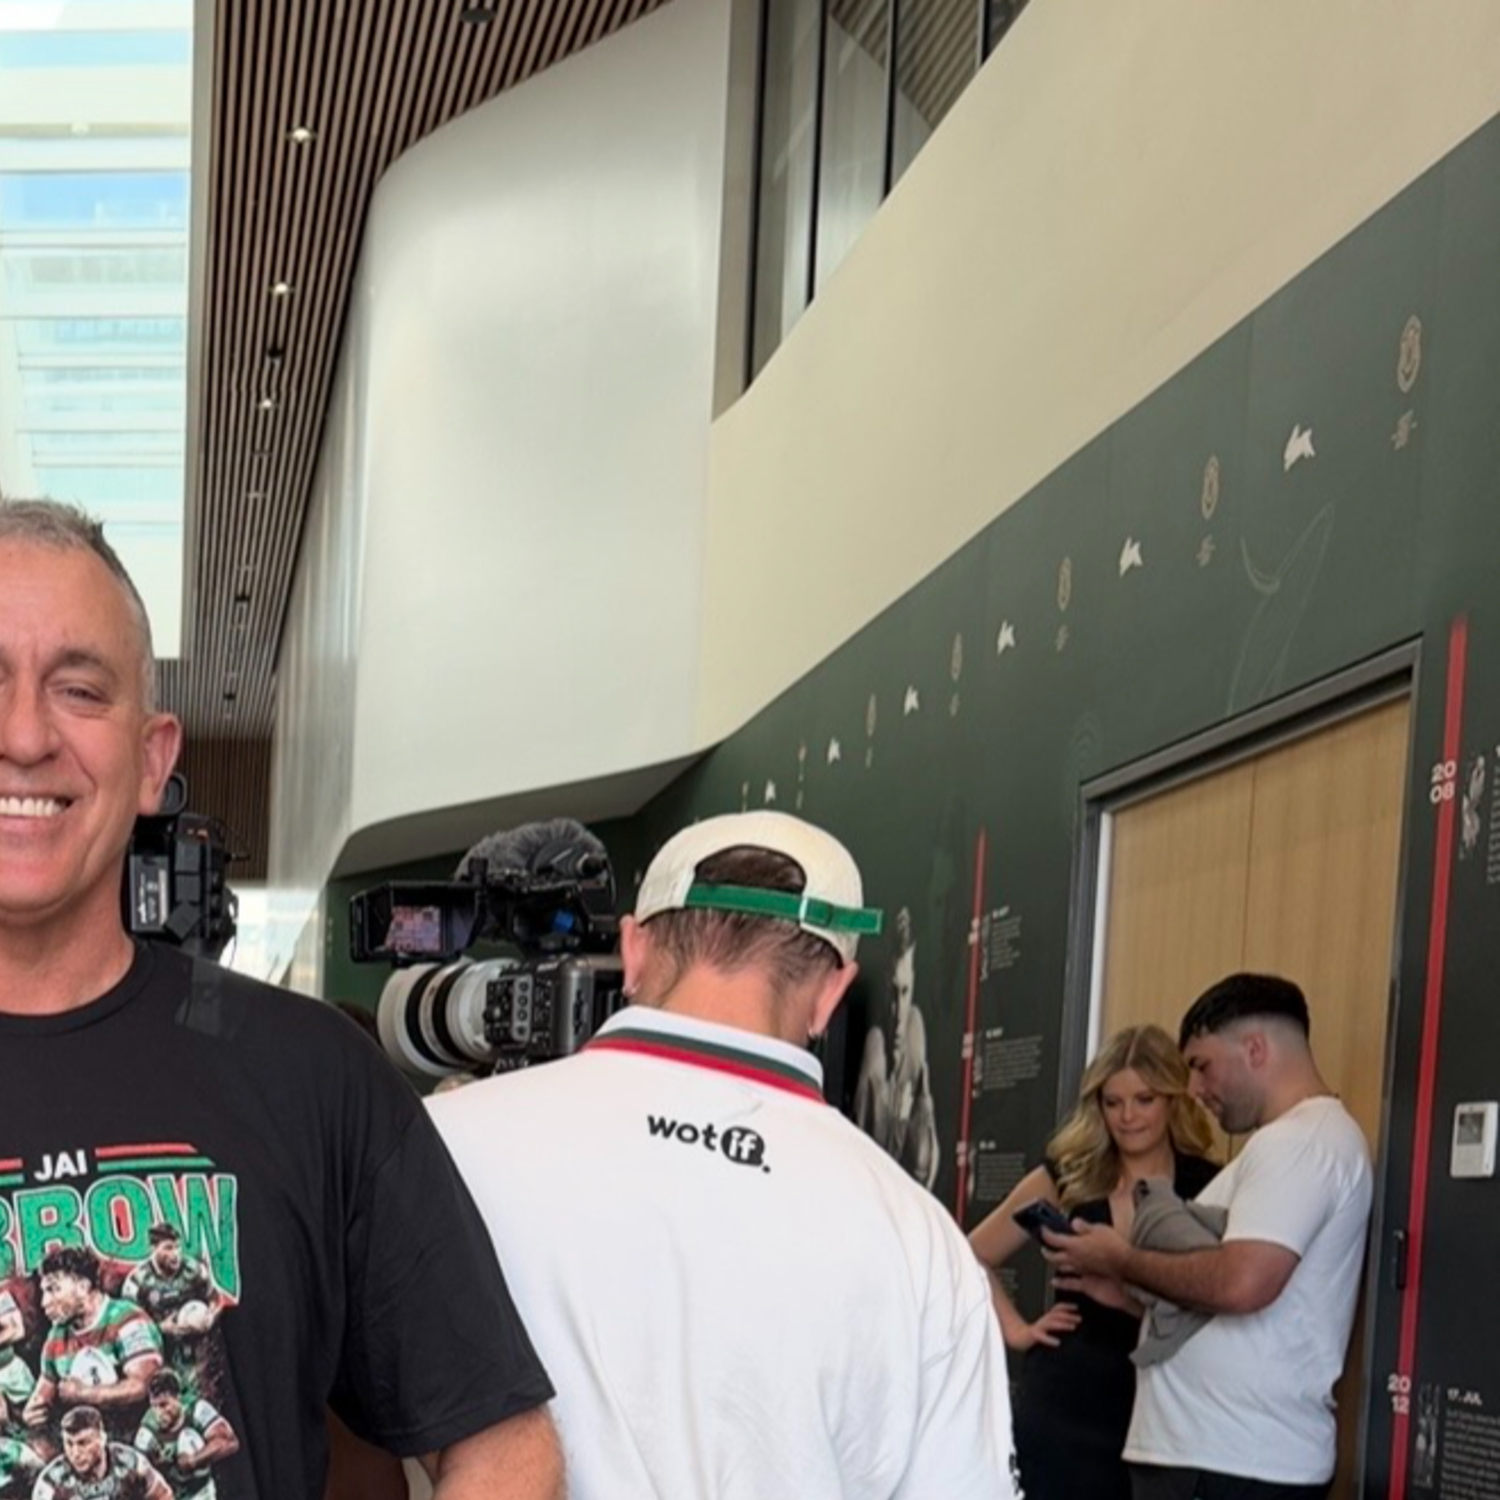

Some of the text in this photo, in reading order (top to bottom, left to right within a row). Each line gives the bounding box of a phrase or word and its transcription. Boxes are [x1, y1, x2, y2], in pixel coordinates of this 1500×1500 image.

[1431, 760, 1457, 783] 20
[34, 1149, 88, 1181] JAI
[1387, 1373, 1411, 1393] 20
